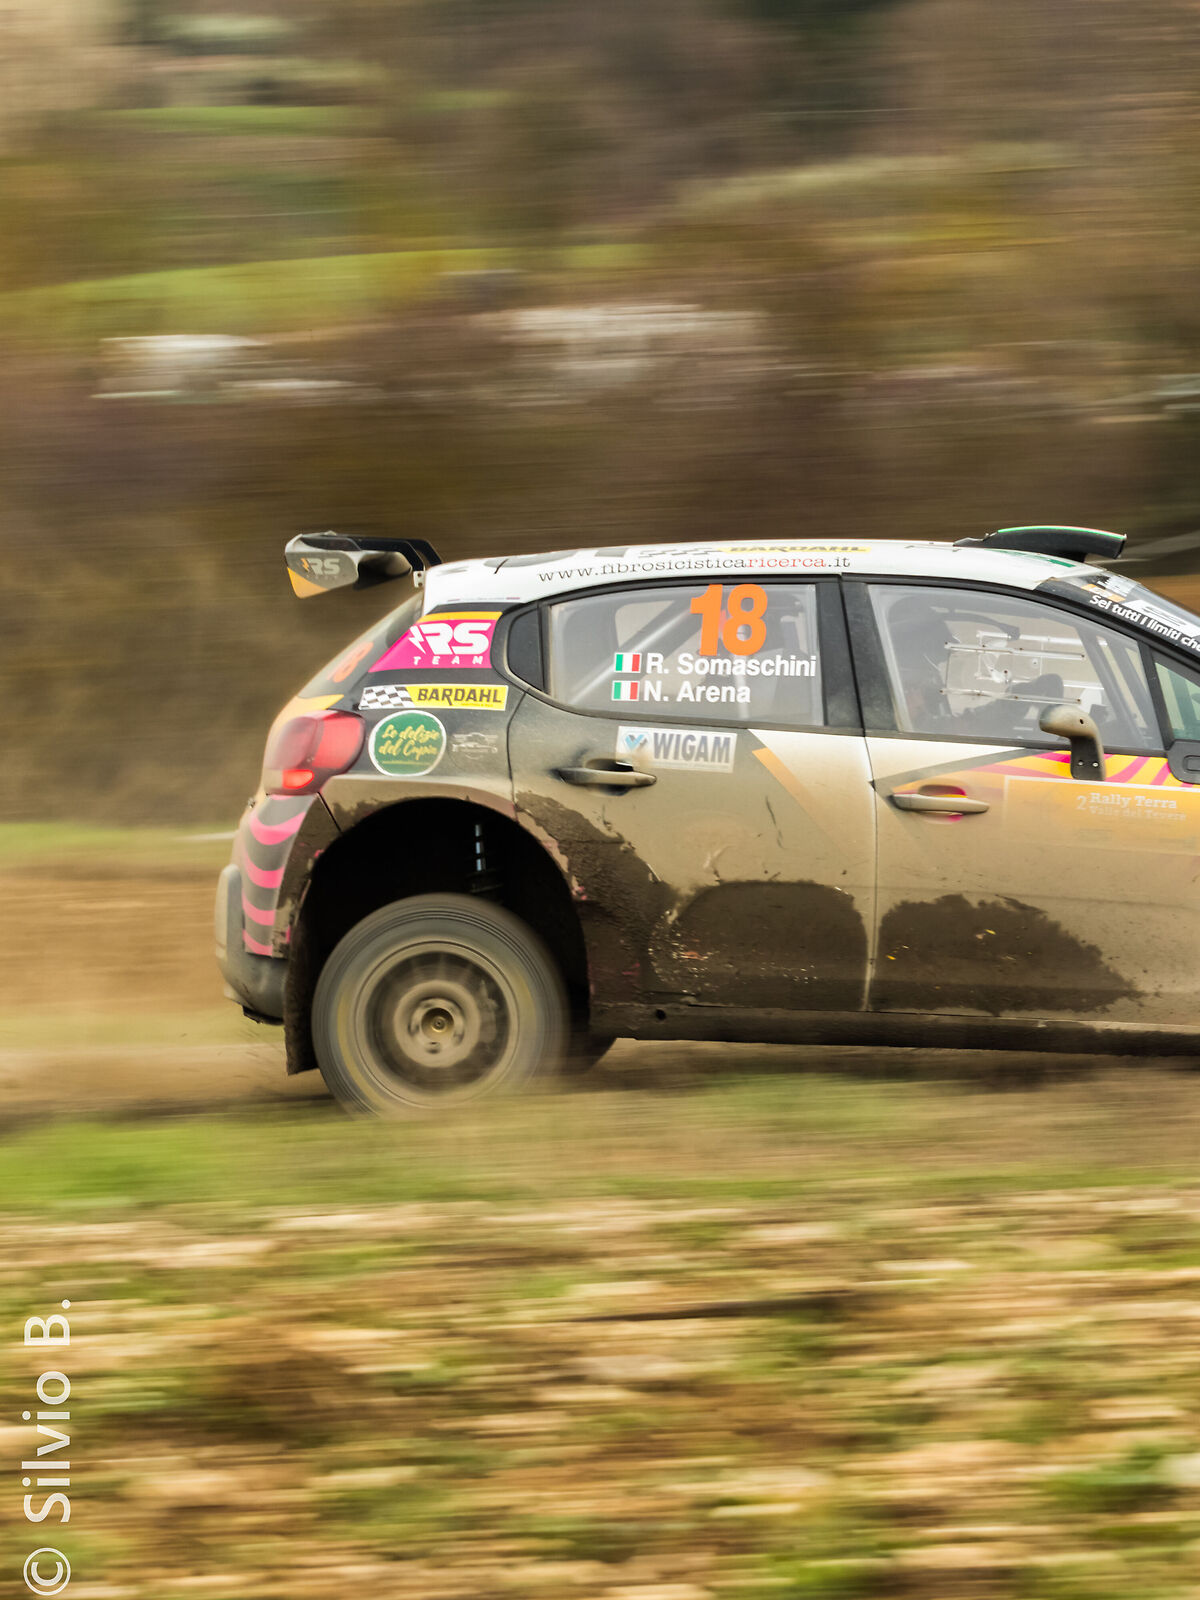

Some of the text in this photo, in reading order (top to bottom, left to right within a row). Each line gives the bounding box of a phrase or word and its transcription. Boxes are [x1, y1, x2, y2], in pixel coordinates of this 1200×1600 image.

[308, 558, 341, 575] RS
[538, 556, 851, 582] www.fibrosicisticaricerca.it
[690, 583, 768, 657] 18
[1112, 604, 1141, 623] tutti
[414, 622, 492, 655] RS
[413, 655, 484, 666] TEAM
[646, 653, 817, 677] R. Somaschini
[417, 688, 502, 706] BARDAHL
[643, 680, 751, 703] N. Arena
[653, 733, 731, 764] WIGAM
[1089, 792, 1132, 808] Rally
[1134, 795, 1177, 809] Terra
